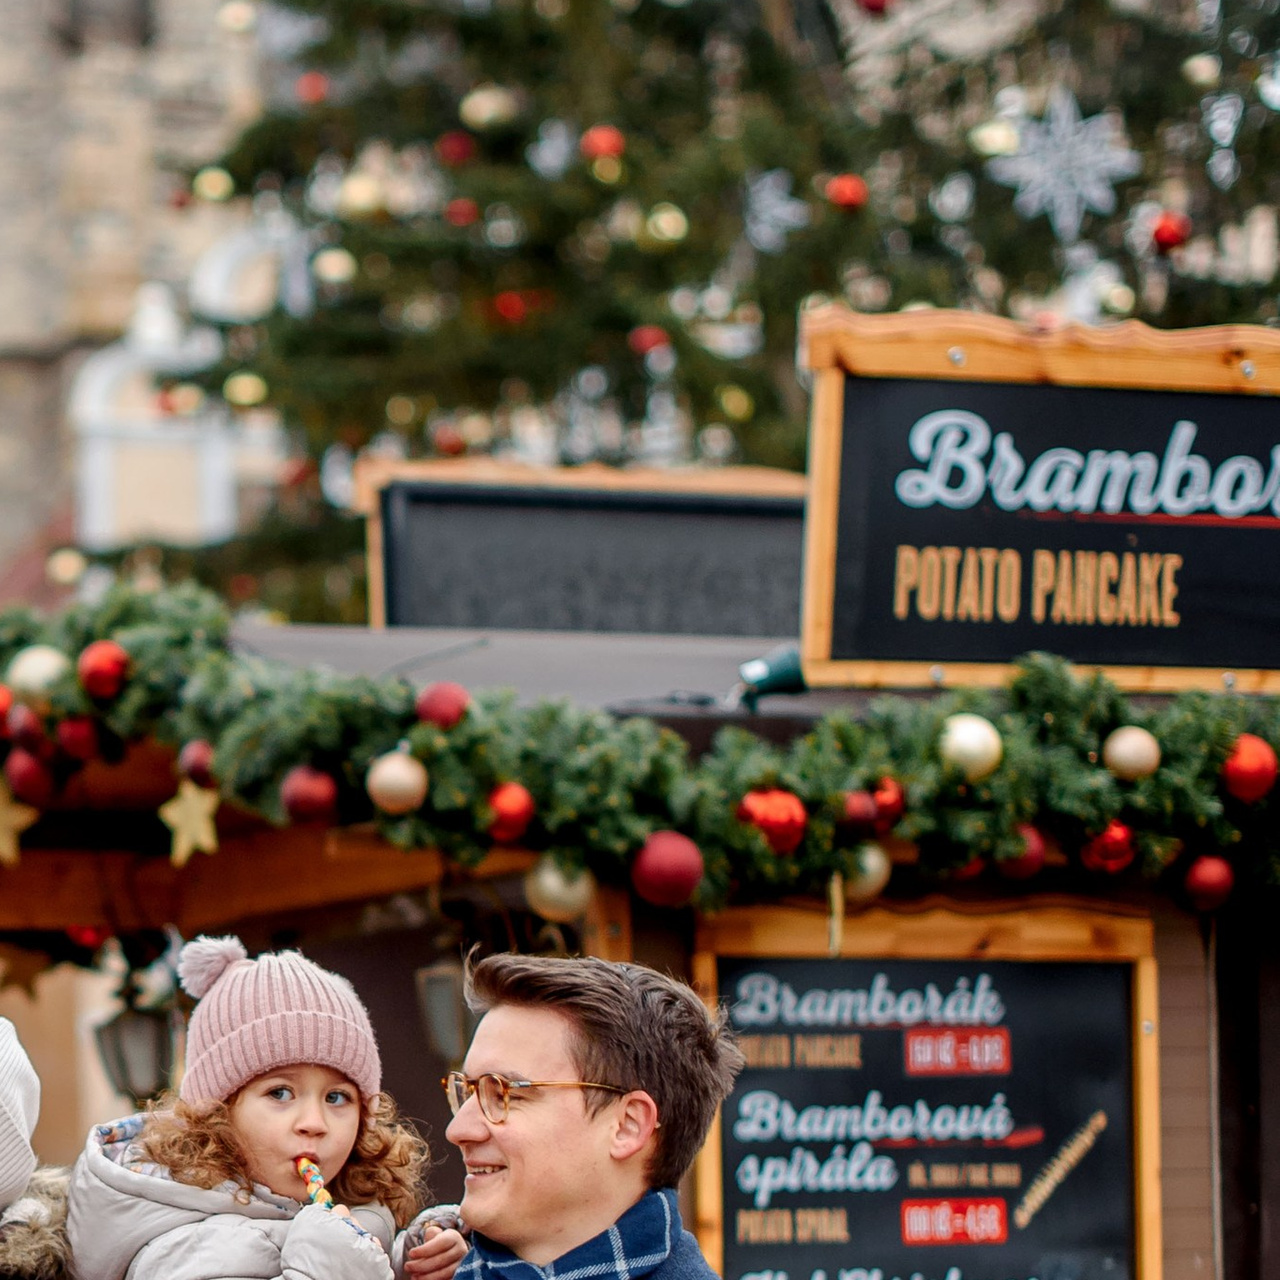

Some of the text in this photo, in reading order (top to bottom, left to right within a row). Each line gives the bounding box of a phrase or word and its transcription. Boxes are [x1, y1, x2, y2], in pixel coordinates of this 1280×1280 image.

[893, 545, 1183, 627] POTATO PANCAKE
[734, 973, 1006, 1026] Bramborák
[733, 1090, 1014, 1142] Bramborová
[736, 1142, 898, 1209] spirála
